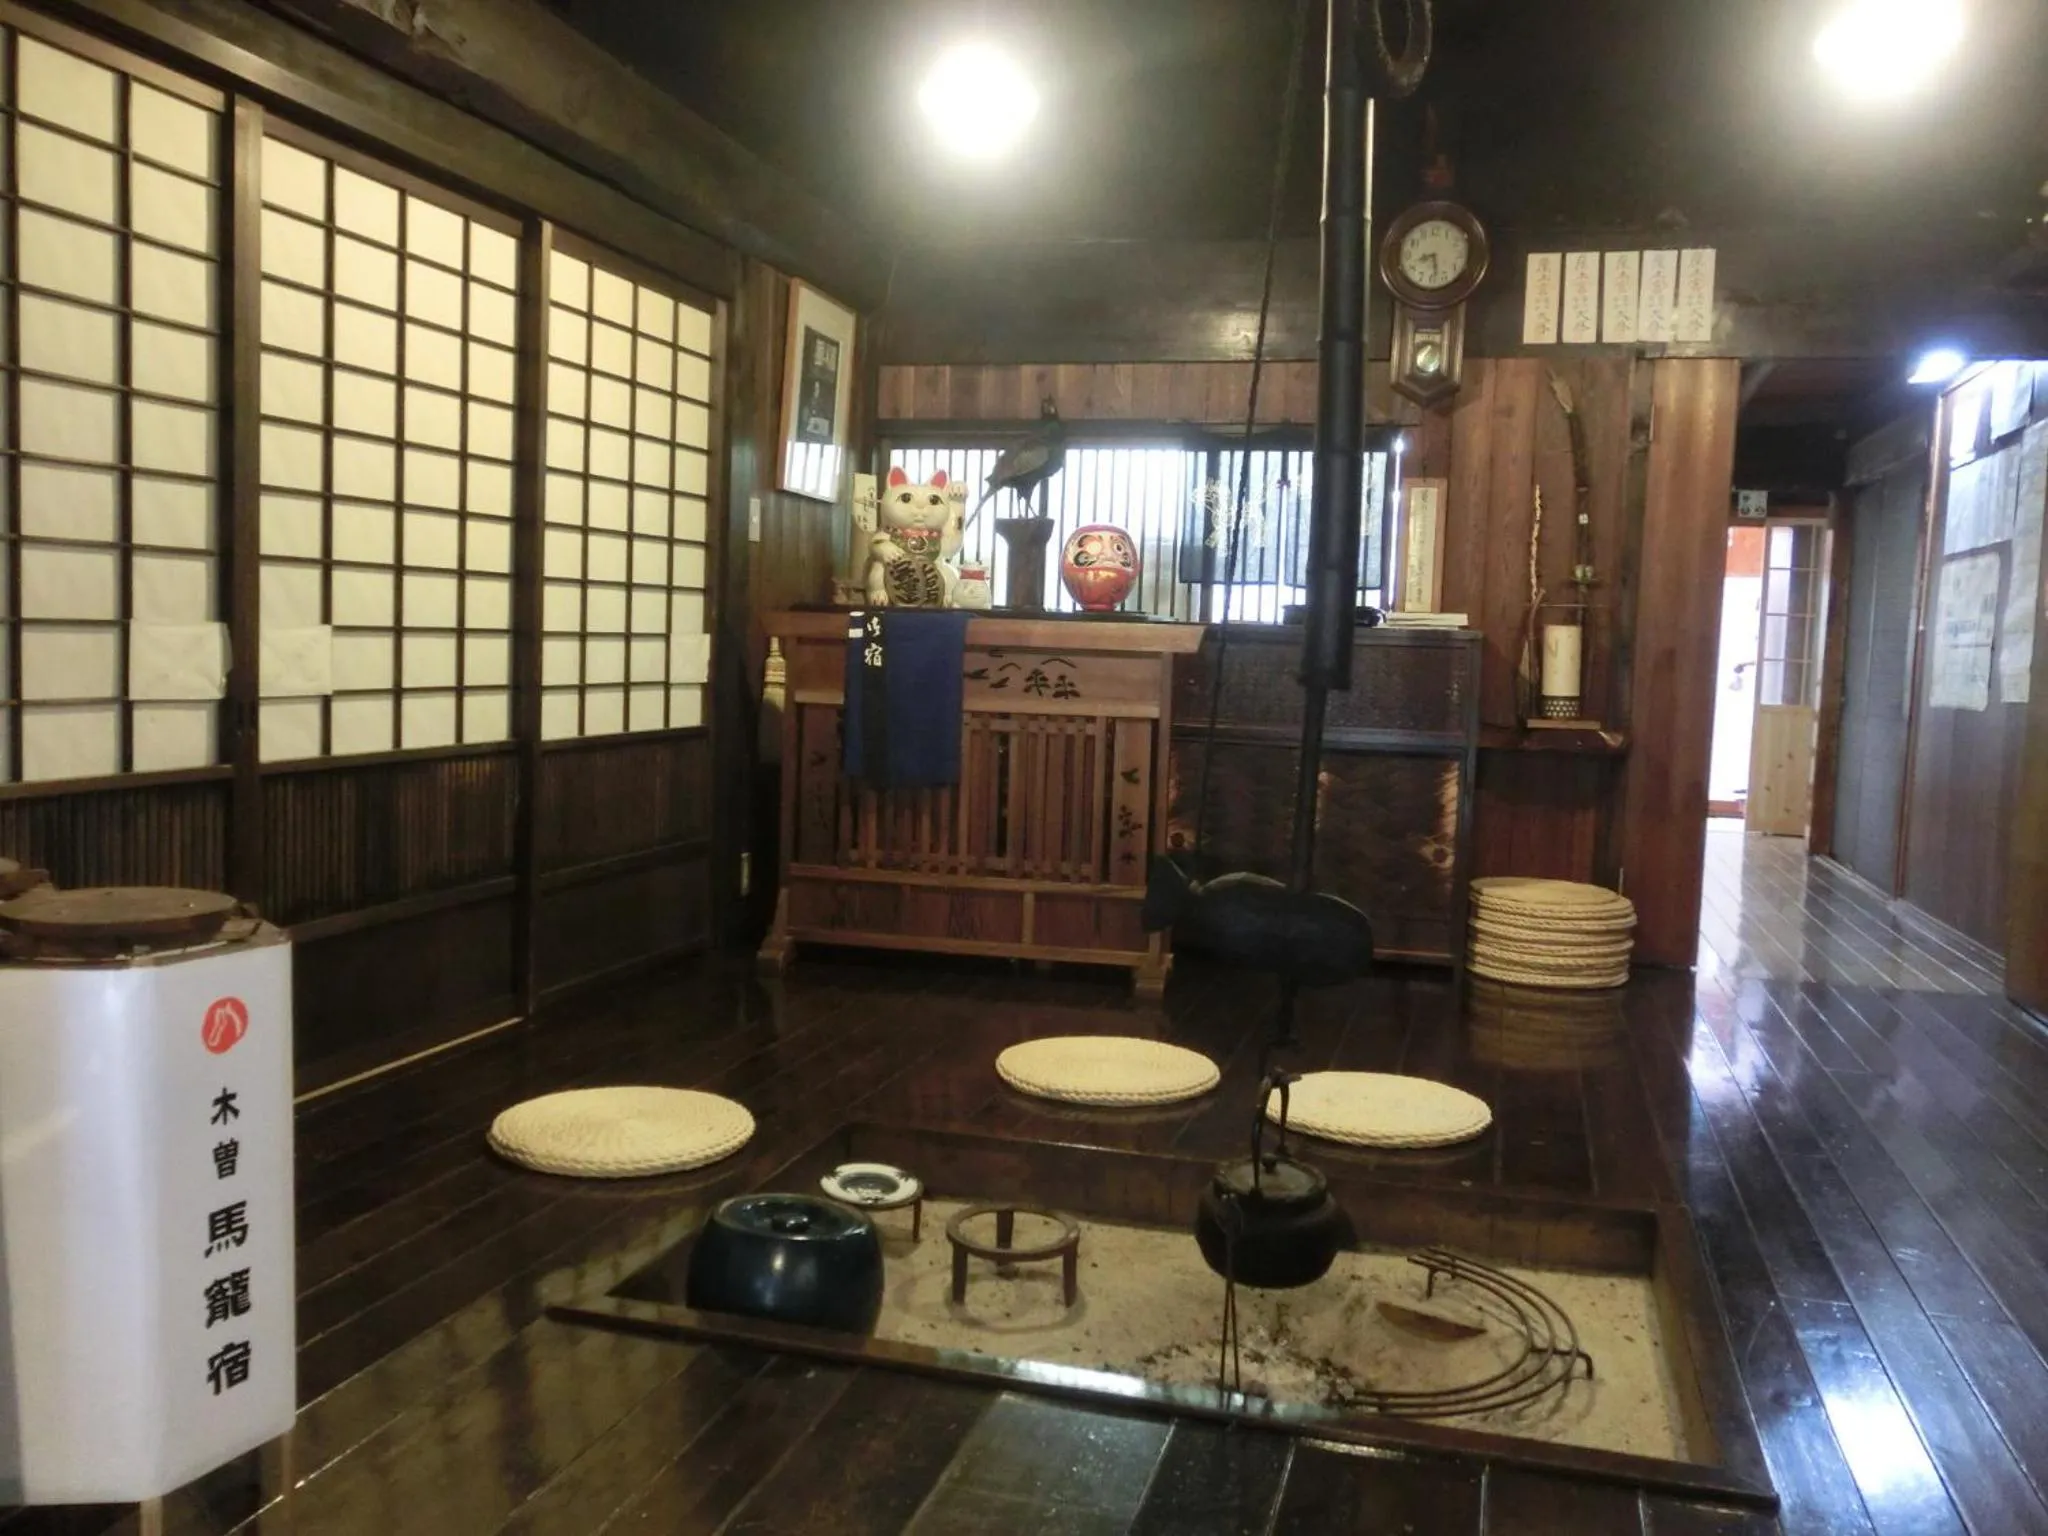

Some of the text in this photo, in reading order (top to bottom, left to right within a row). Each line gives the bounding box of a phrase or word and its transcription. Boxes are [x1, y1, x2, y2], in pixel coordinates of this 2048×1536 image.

[204, 1087, 252, 1396] 木曽馬籠宿
